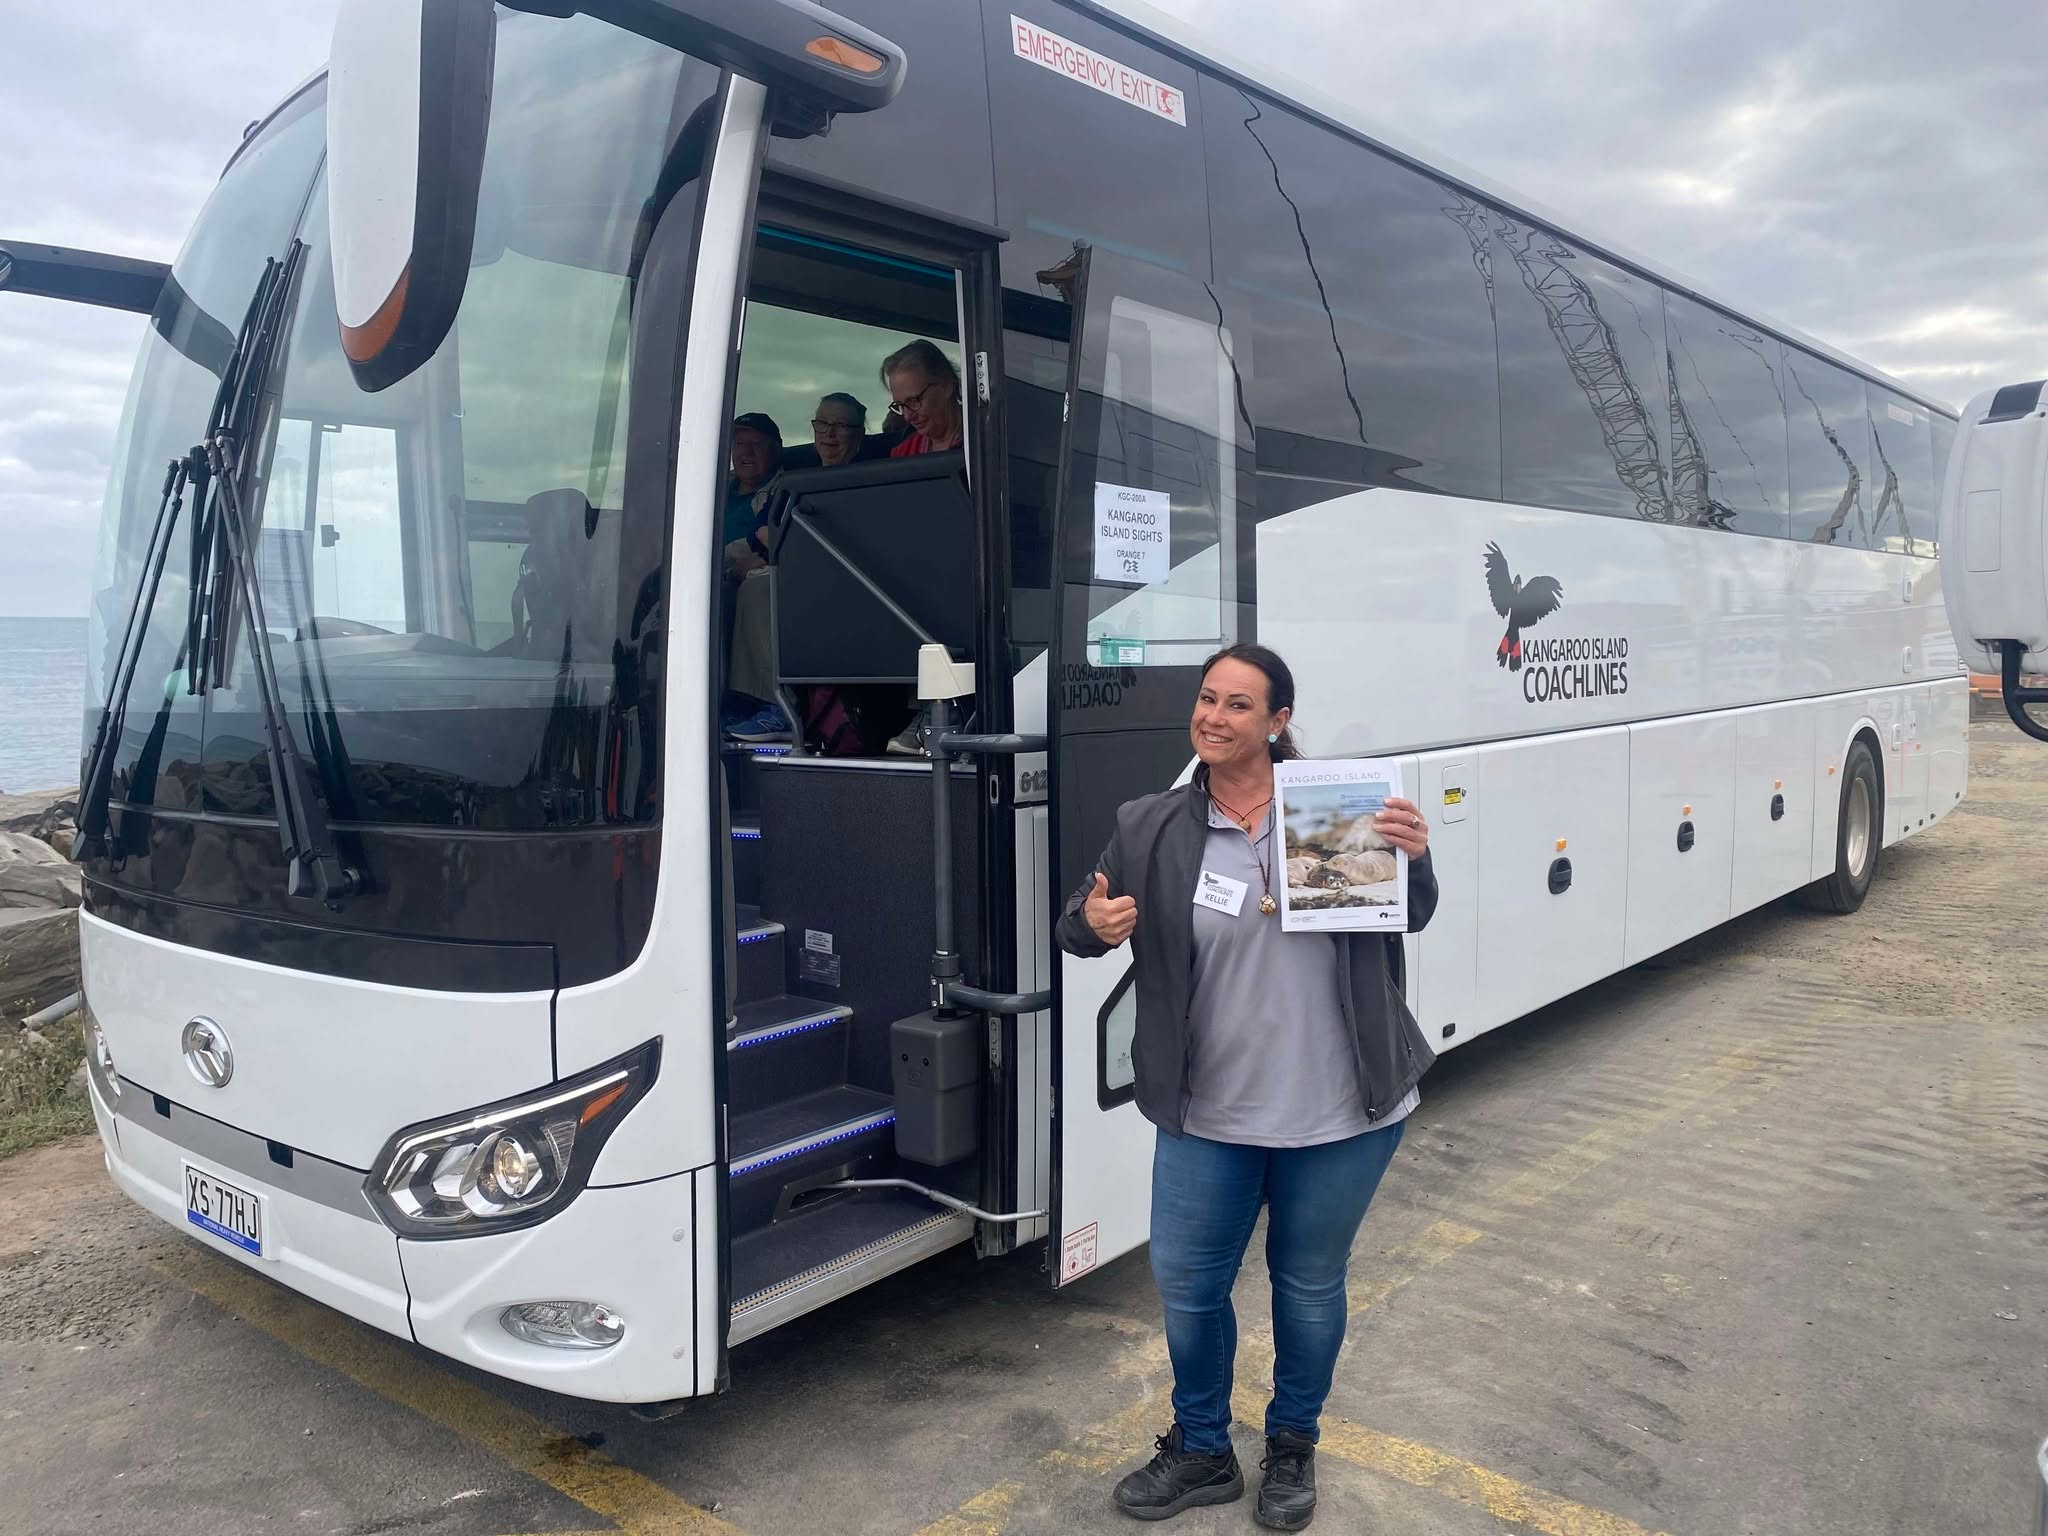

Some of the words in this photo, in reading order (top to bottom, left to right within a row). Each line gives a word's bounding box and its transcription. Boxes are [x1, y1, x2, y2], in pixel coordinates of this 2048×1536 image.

[1017, 25, 1115, 91] EMERGENCY
[1121, 71, 1152, 107] EXIT
[1108, 509, 1156, 525] KANGAROO
[1101, 525, 1130, 539] ISLAND
[1132, 529, 1163, 543] SIGHTS
[1117, 550, 1141, 559] ORANGE
[1523, 638, 1590, 663] KANGAROO
[1592, 637, 1628, 659] ISLAND
[1523, 662, 1628, 703] COACHLINES
[1281, 775, 1341, 784] KANGAROO
[1345, 772, 1381, 781] ISLAND
[1205, 893, 1229, 906] KELLIE
